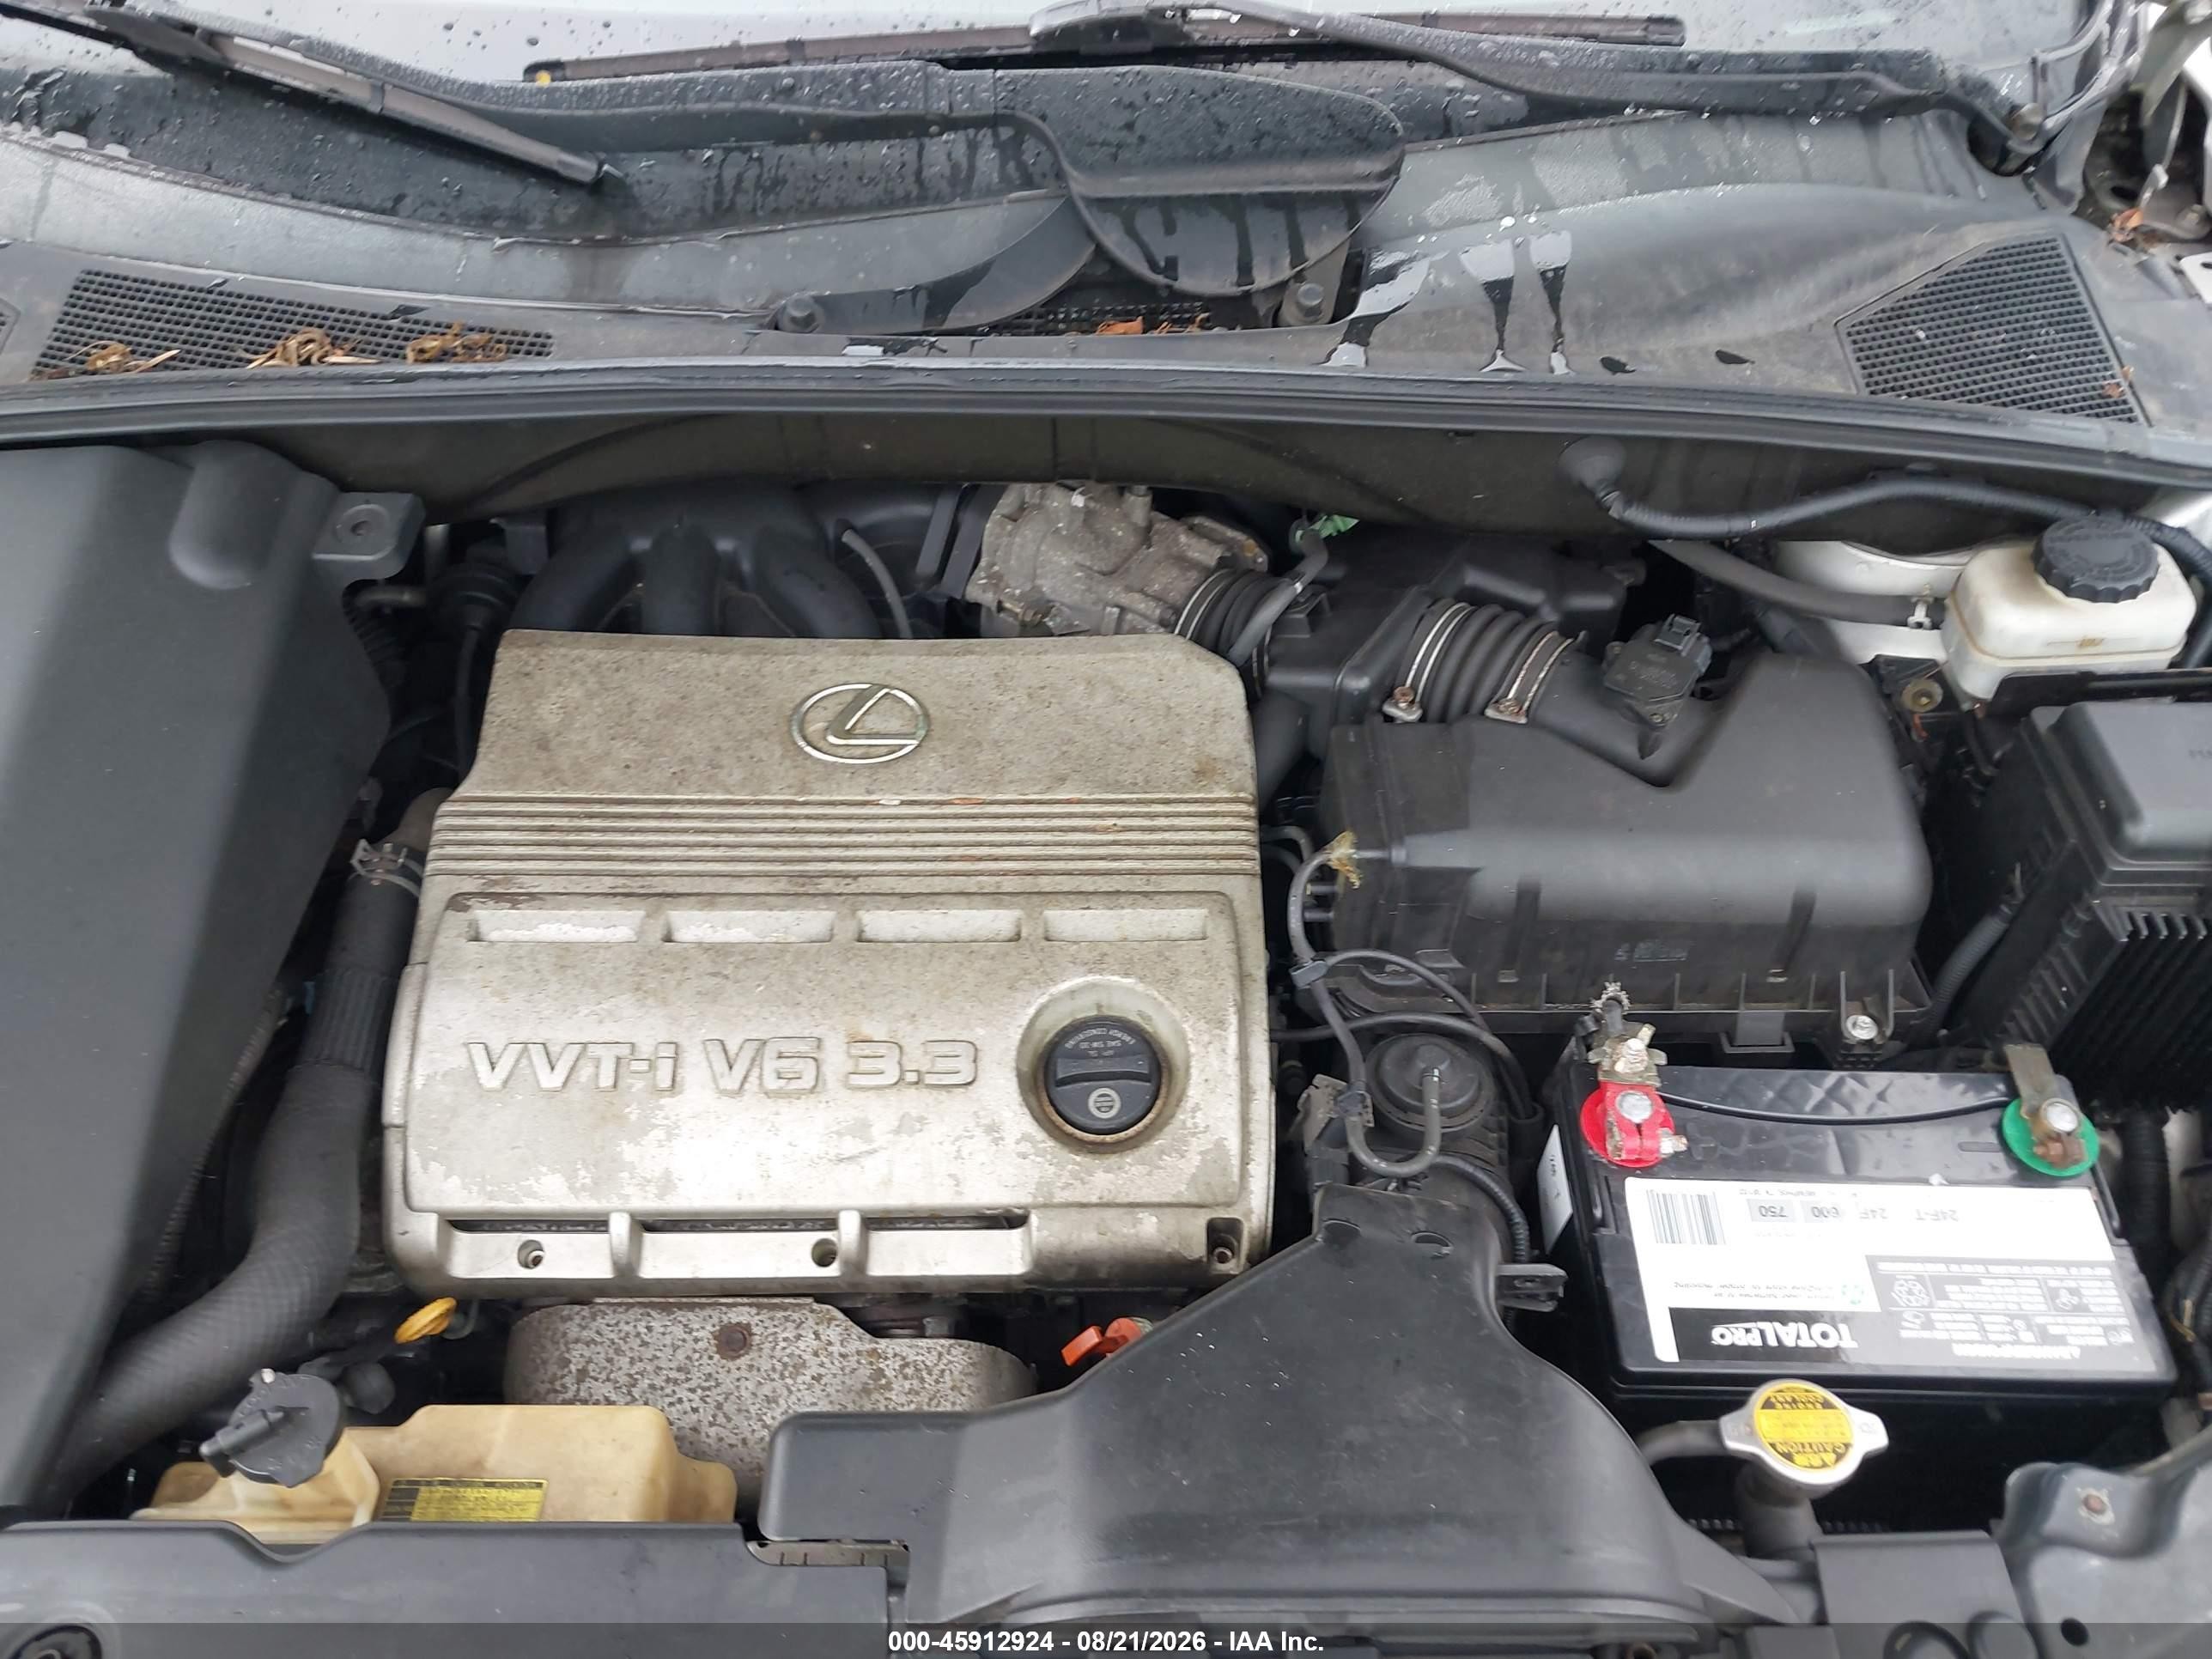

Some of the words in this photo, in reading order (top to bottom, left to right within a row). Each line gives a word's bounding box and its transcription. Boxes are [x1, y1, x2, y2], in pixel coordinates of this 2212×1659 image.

[465, 1041, 678, 1092] VVT-i
[703, 1036, 822, 1094] V6
[846, 1039, 979, 1087] 3.3
[1758, 1205, 1788, 1218] 750
[1775, 1442, 1846, 1455] CAUTION
